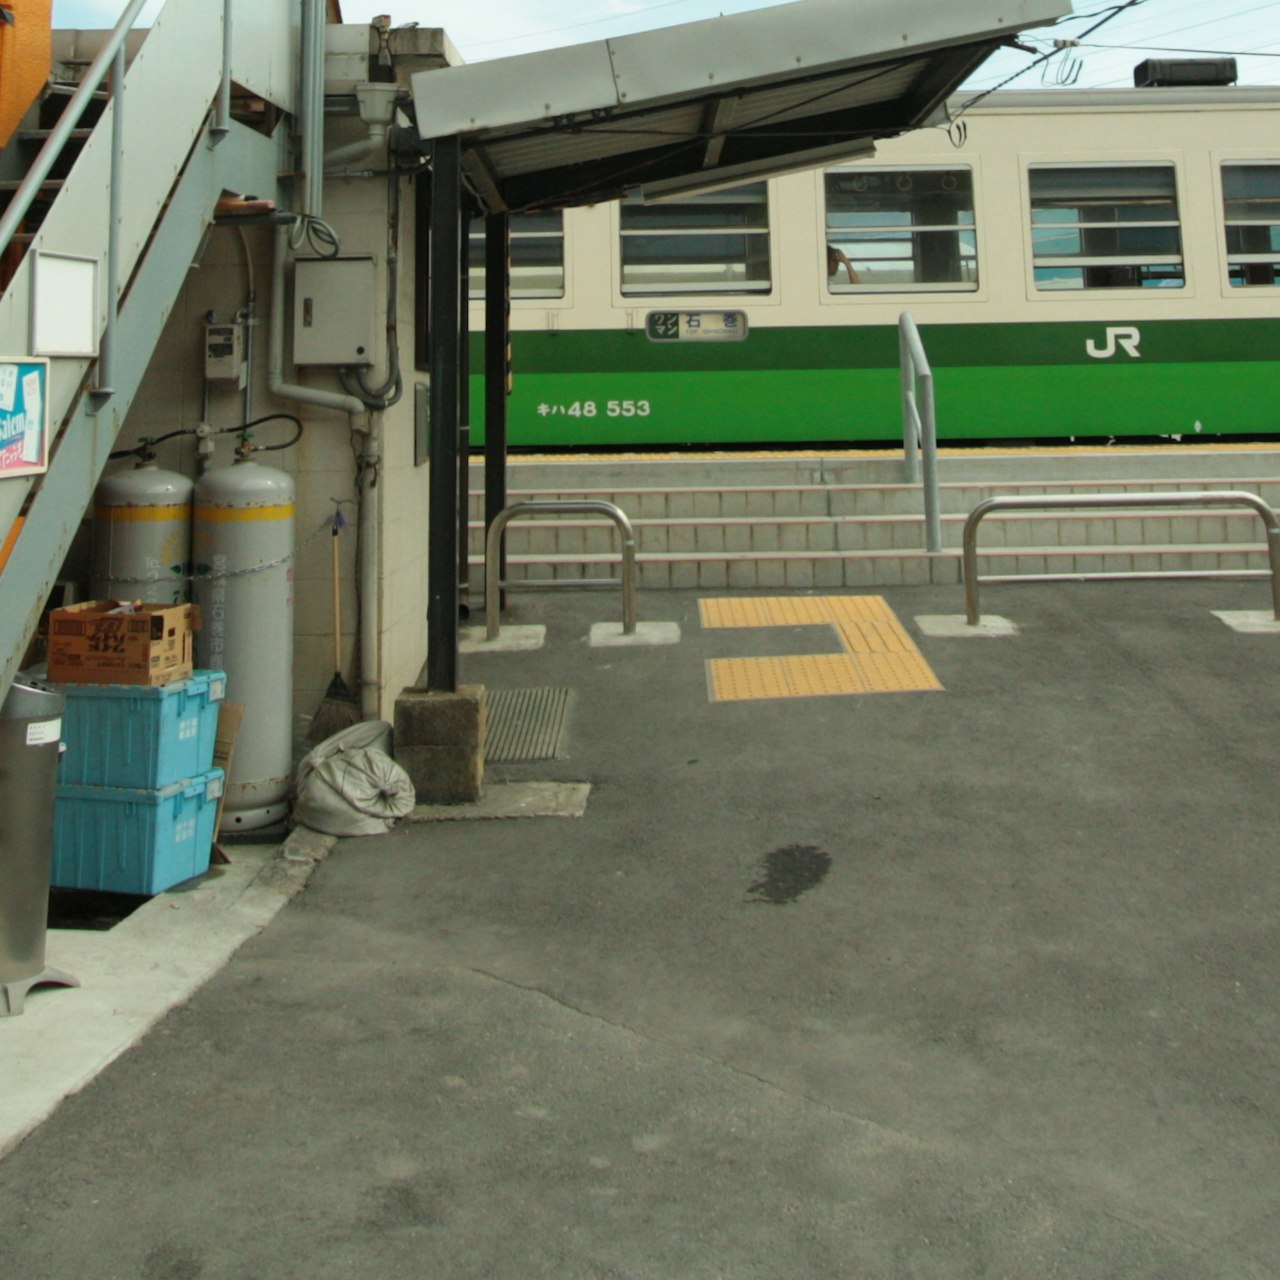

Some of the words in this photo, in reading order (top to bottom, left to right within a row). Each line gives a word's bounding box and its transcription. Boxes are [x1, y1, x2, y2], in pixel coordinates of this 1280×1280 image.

[1086, 326, 1141, 358] JR
[537, 401, 596, 417] キハ48
[606, 400, 651, 417] 553
